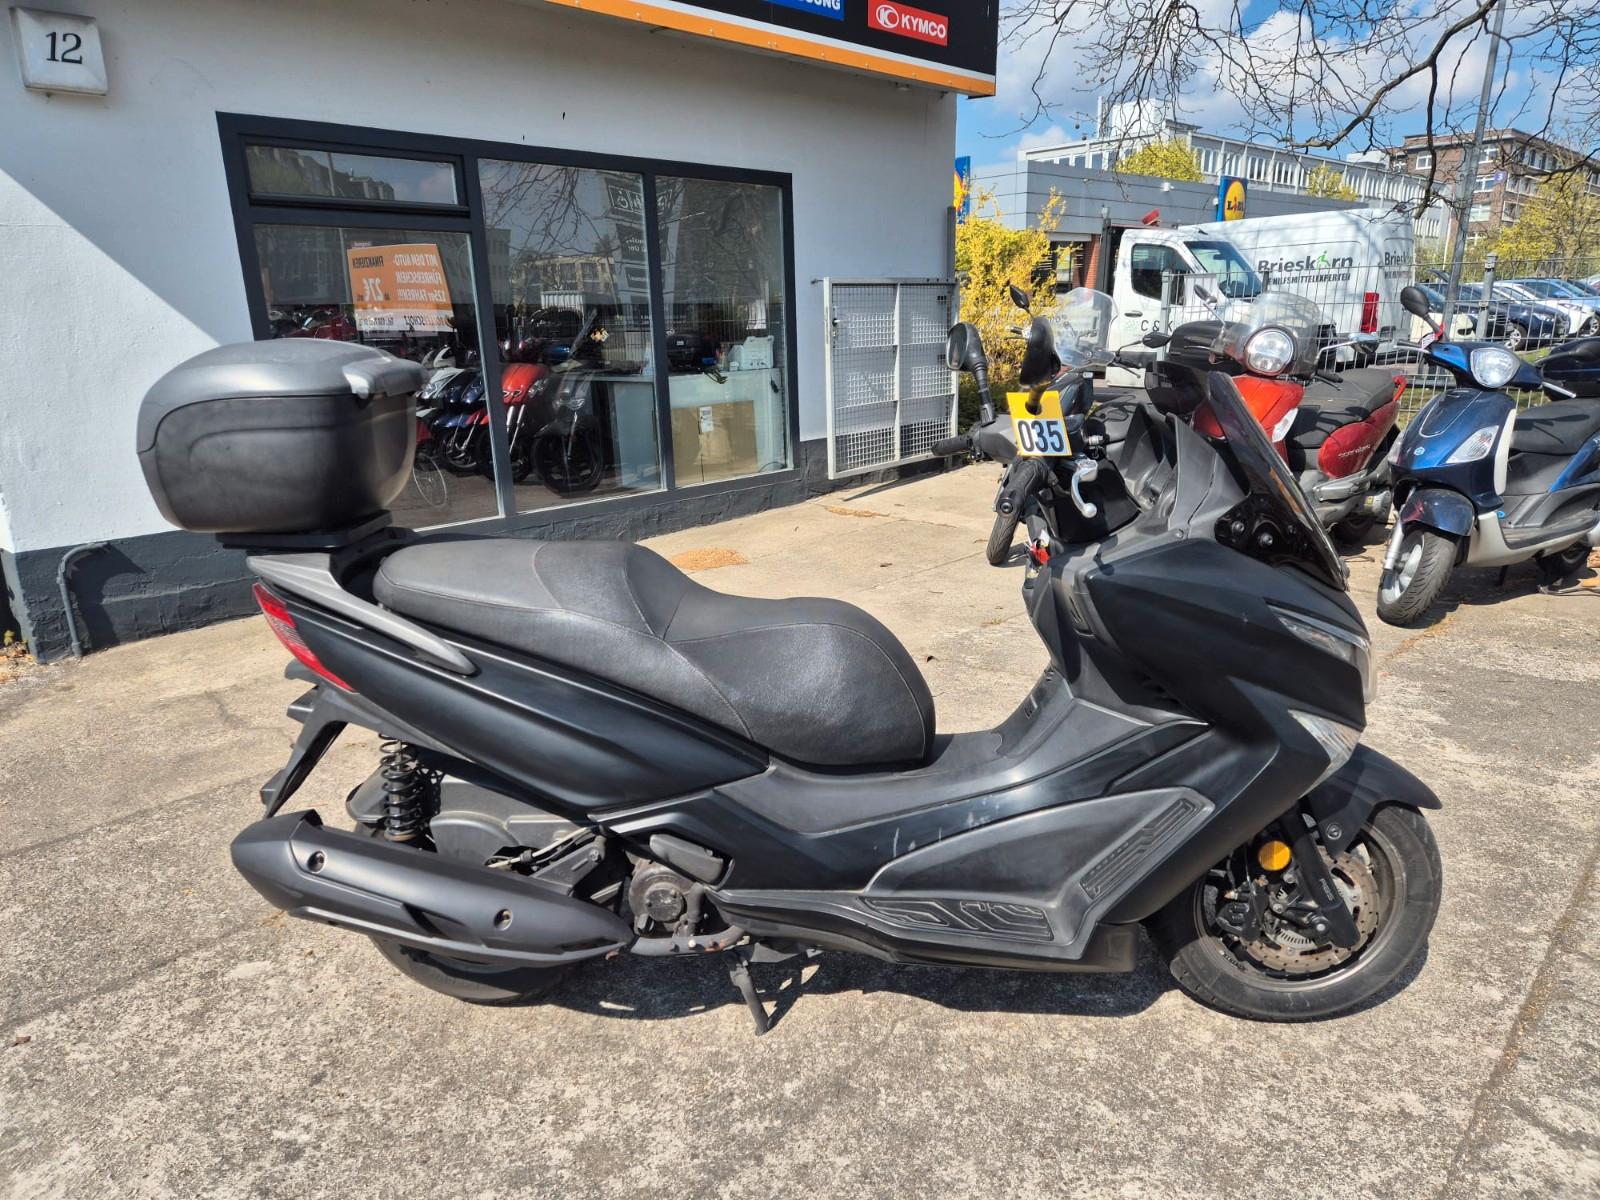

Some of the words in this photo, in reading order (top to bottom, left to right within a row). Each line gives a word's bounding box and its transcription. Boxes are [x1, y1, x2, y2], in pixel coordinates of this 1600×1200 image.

[901, 13, 946, 38] KYMCO
[45, 31, 83, 64] 12
[1140, 319, 1149, 332] C
[1152, 320, 1160, 332] &
[1017, 420, 1065, 453] 035
